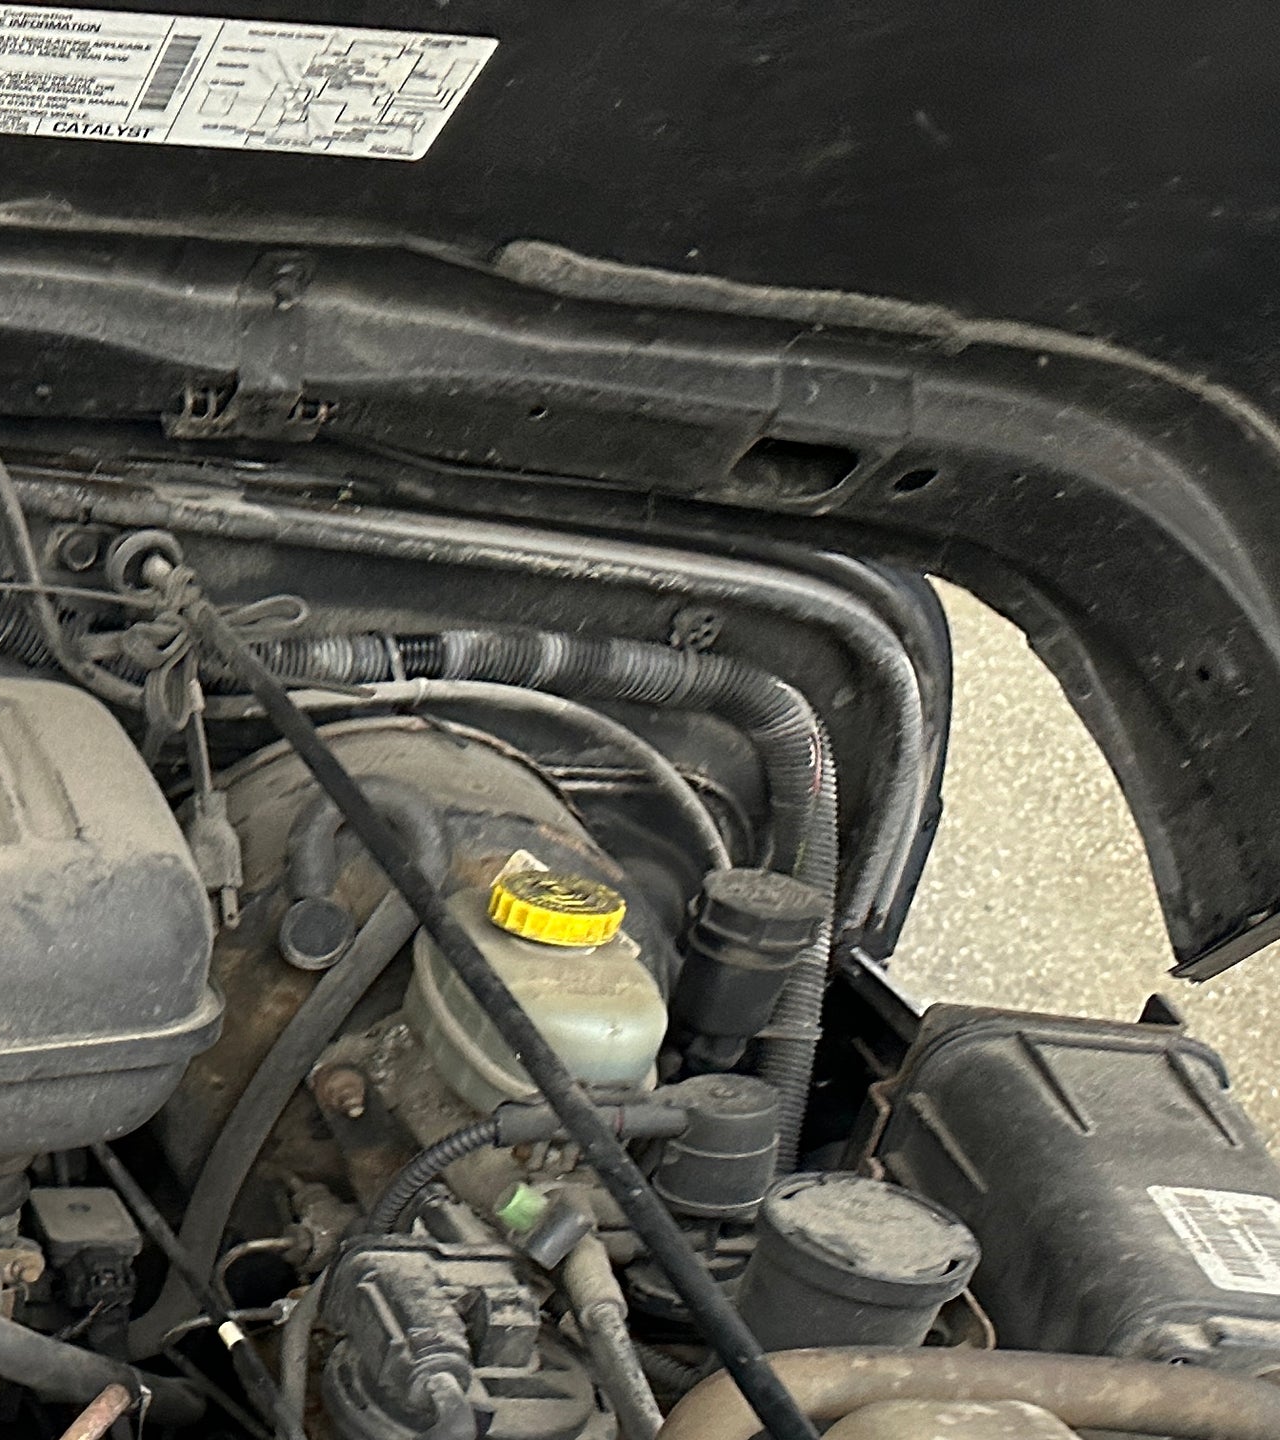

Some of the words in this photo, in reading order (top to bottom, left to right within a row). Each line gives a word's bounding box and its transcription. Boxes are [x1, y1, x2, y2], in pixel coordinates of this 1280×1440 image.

[4, 8, 73, 21] Corporation
[9, 18, 102, 34] INFORMATION
[52, 121, 154, 140] CATALYST
